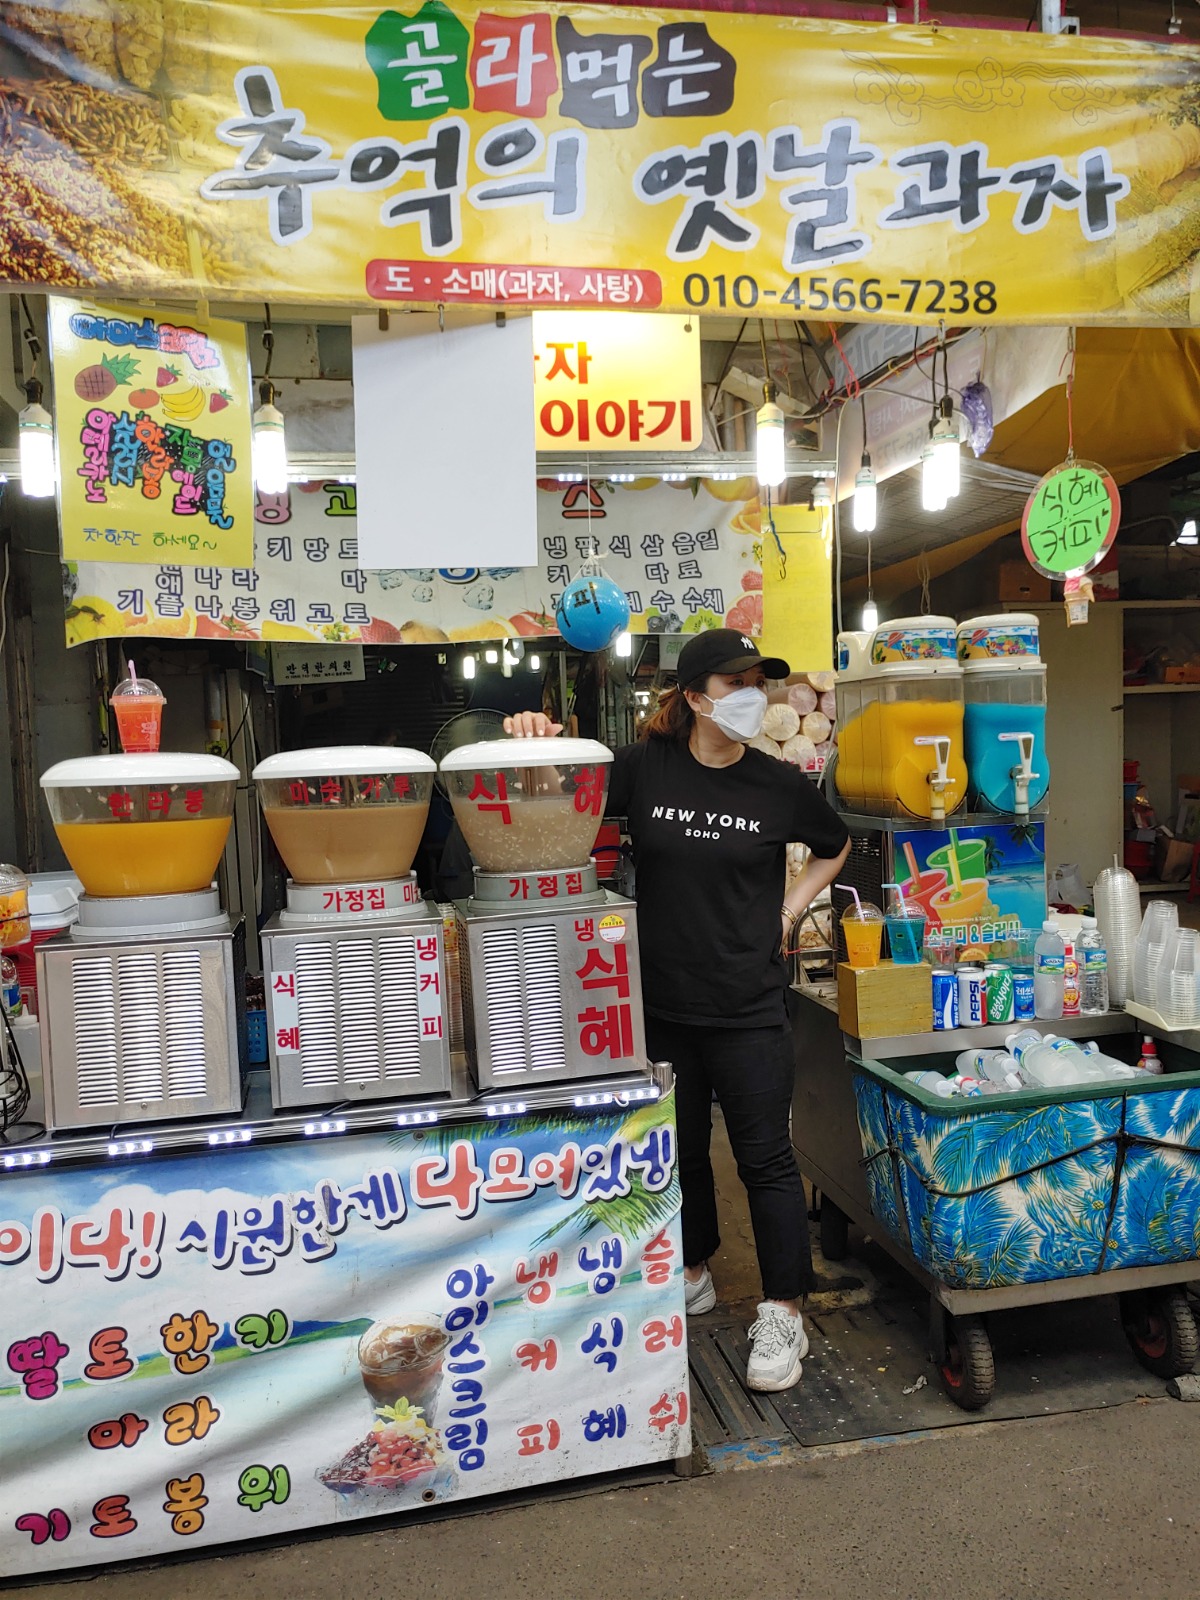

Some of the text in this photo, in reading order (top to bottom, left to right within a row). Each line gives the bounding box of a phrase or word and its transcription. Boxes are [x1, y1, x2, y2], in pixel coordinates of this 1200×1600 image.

[206, 71, 584, 252] 추억의
[578, 274, 644, 304] 사탕)
[683, 271, 998, 315] 010-4566-7238
[533, 340, 593, 385] 자
[539, 398, 693, 443] 이야기
[1041, 470, 1100, 519] 식혜
[1039, 515, 1102, 563] 커피
[107, 788, 205, 818] 한라봉
[468, 765, 607, 826] 식혜
[652, 805, 762, 834] NEW YORK
[684, 827, 721, 840] SOHO
[321, 887, 387, 914] 가정집
[508, 872, 584, 901] 가정집
[415, 936, 443, 1040] 냉커피
[970, 980, 980, 1022] PEPSI
[272, 971, 300, 1052] 식혜
[444, 1263, 495, 1473] 아이스크림
